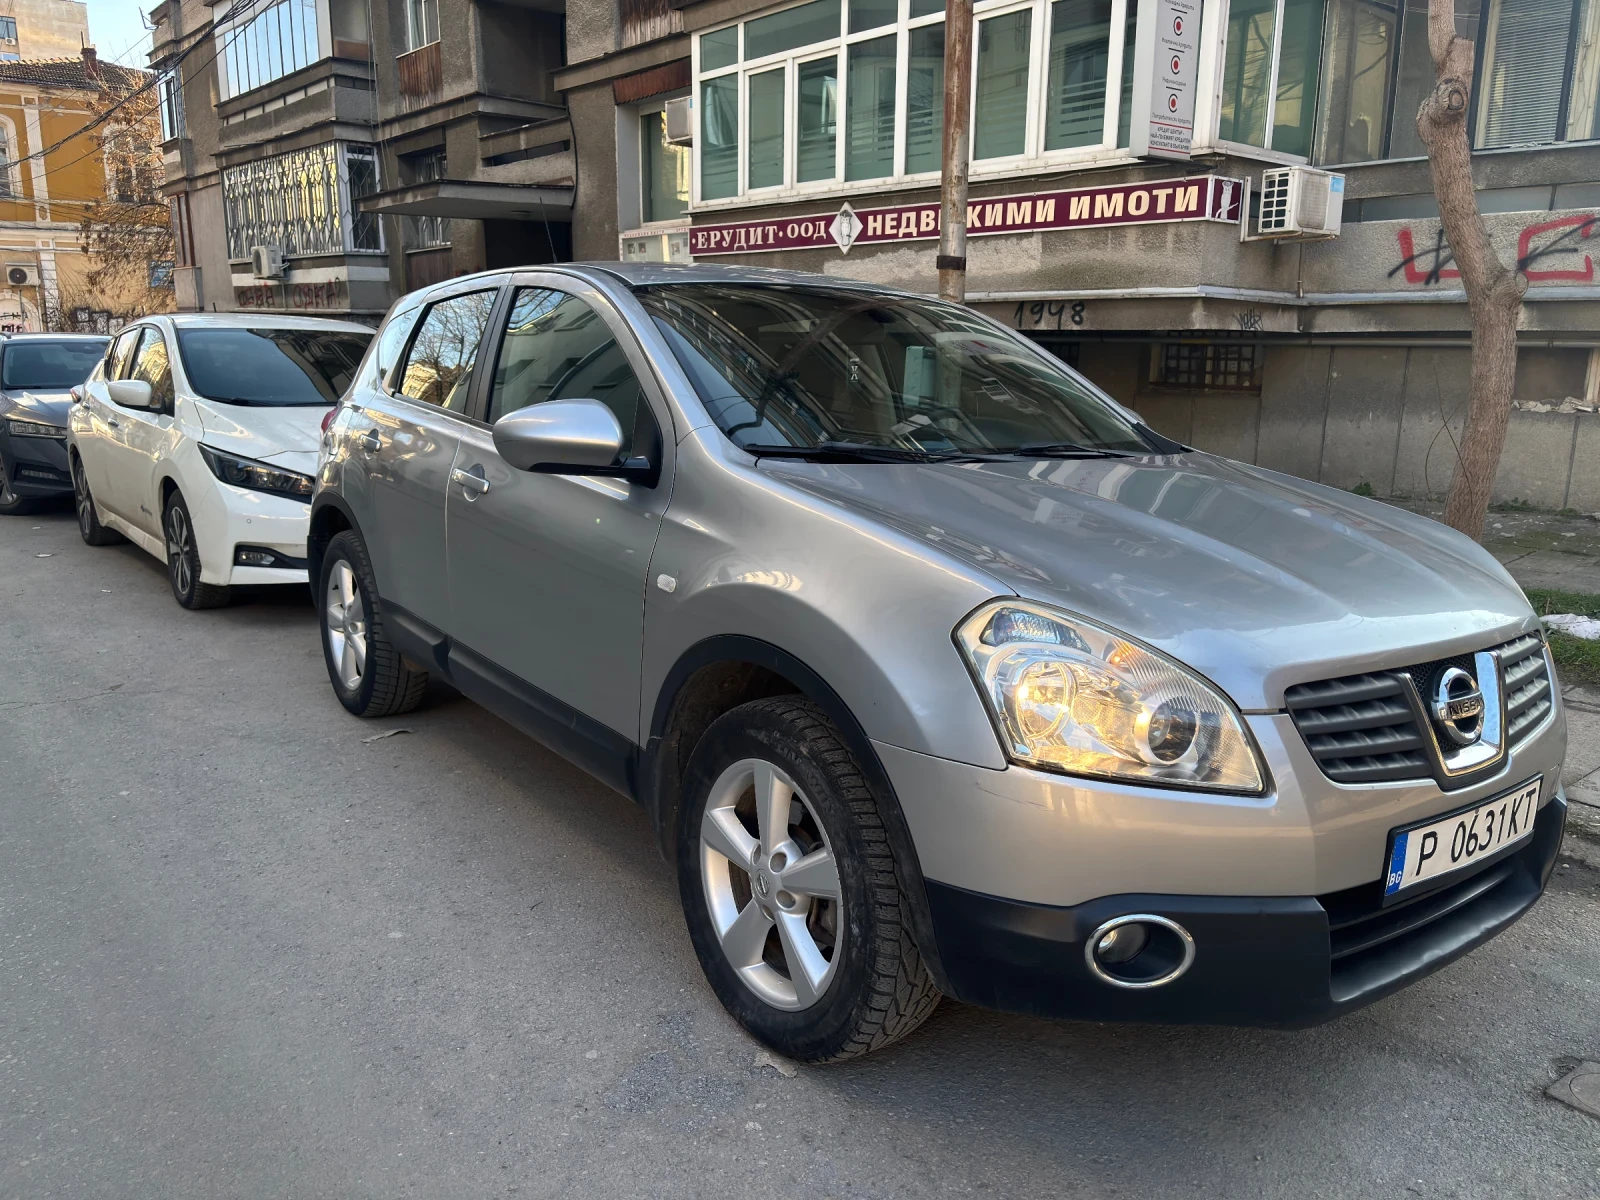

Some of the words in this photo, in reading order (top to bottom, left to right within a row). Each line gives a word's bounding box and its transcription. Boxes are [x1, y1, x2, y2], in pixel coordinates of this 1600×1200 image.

[867, 198, 1056, 237] НЕДВЖИМИ
[1068, 185, 1199, 221] ИМОТИ
[786, 221, 827, 240] ООД
[1013, 301, 1086, 330] 1948
[1449, 698, 1481, 715] NISSA
[1388, 870, 1402, 887] BG
